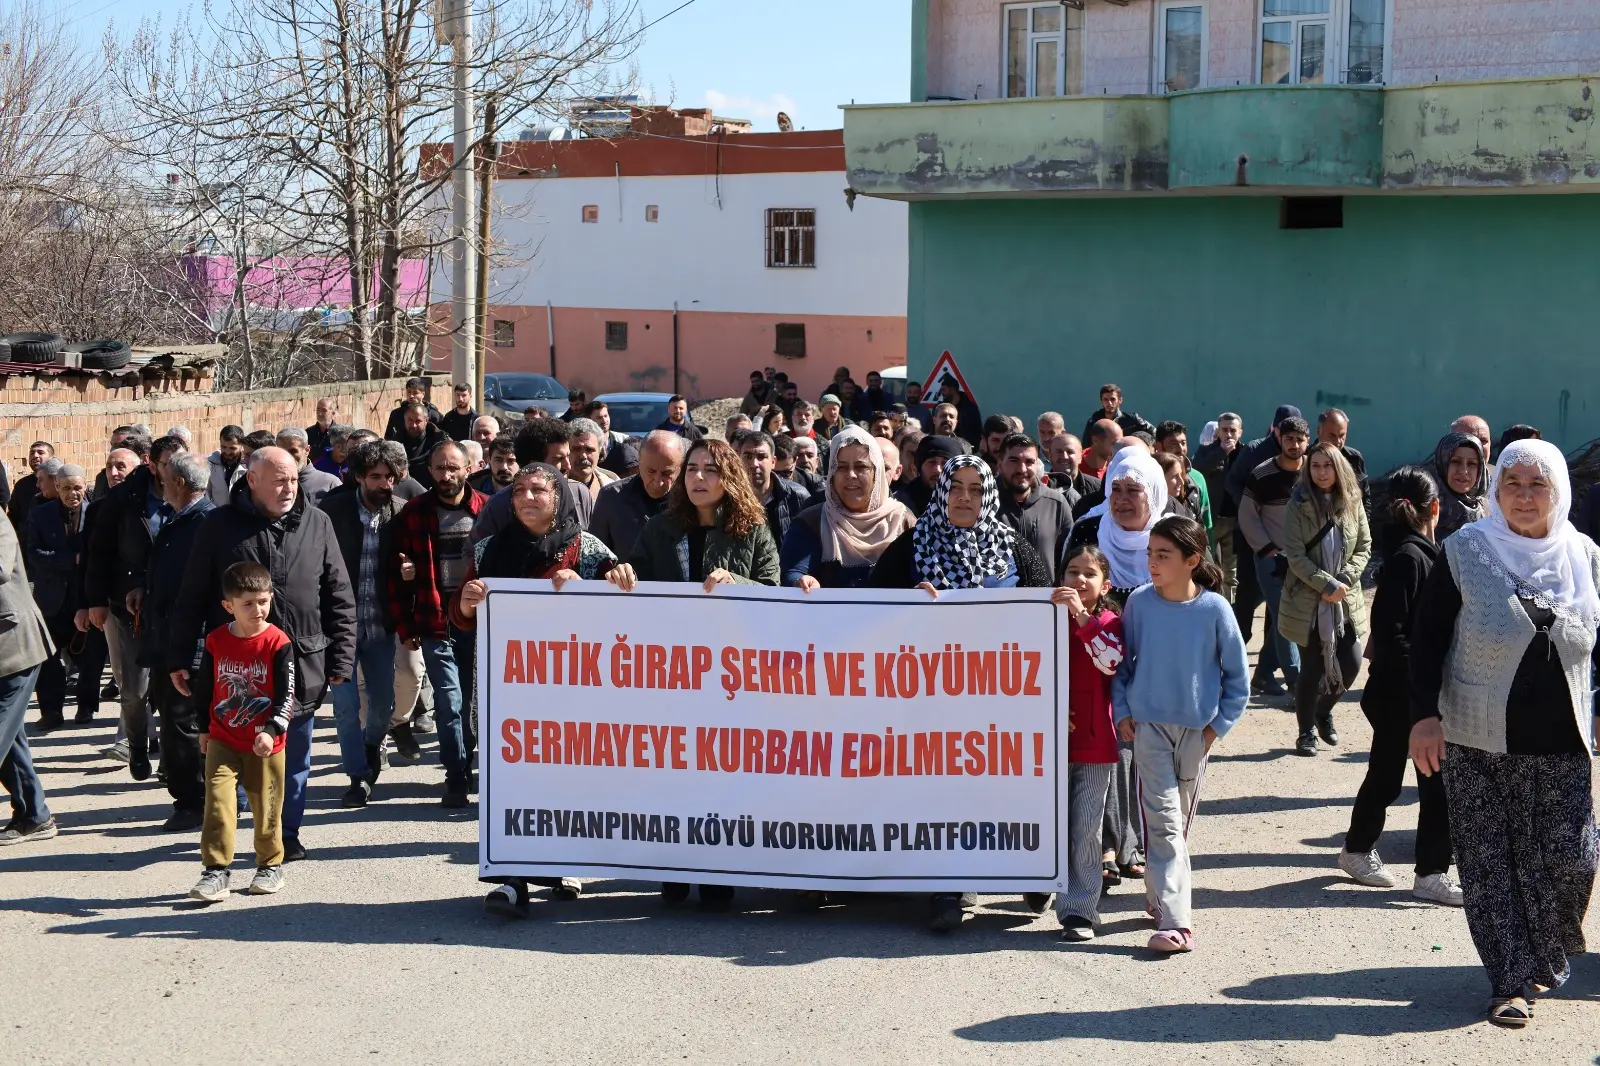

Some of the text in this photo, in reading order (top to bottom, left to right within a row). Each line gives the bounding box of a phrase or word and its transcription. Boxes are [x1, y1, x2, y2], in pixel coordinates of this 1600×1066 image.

[503, 633, 1042, 701] ANTİK ĞIRAP ŞEHRİ VE KÖYÜMÜZ
[501, 718, 688, 770] SERMAYEYE
[695, 726, 833, 778] KURBAN
[840, 723, 1023, 778] EDİLMESİN
[504, 808, 1040, 852] KERVANPINAR KÖYÜ KORUMA PLATFORMU
